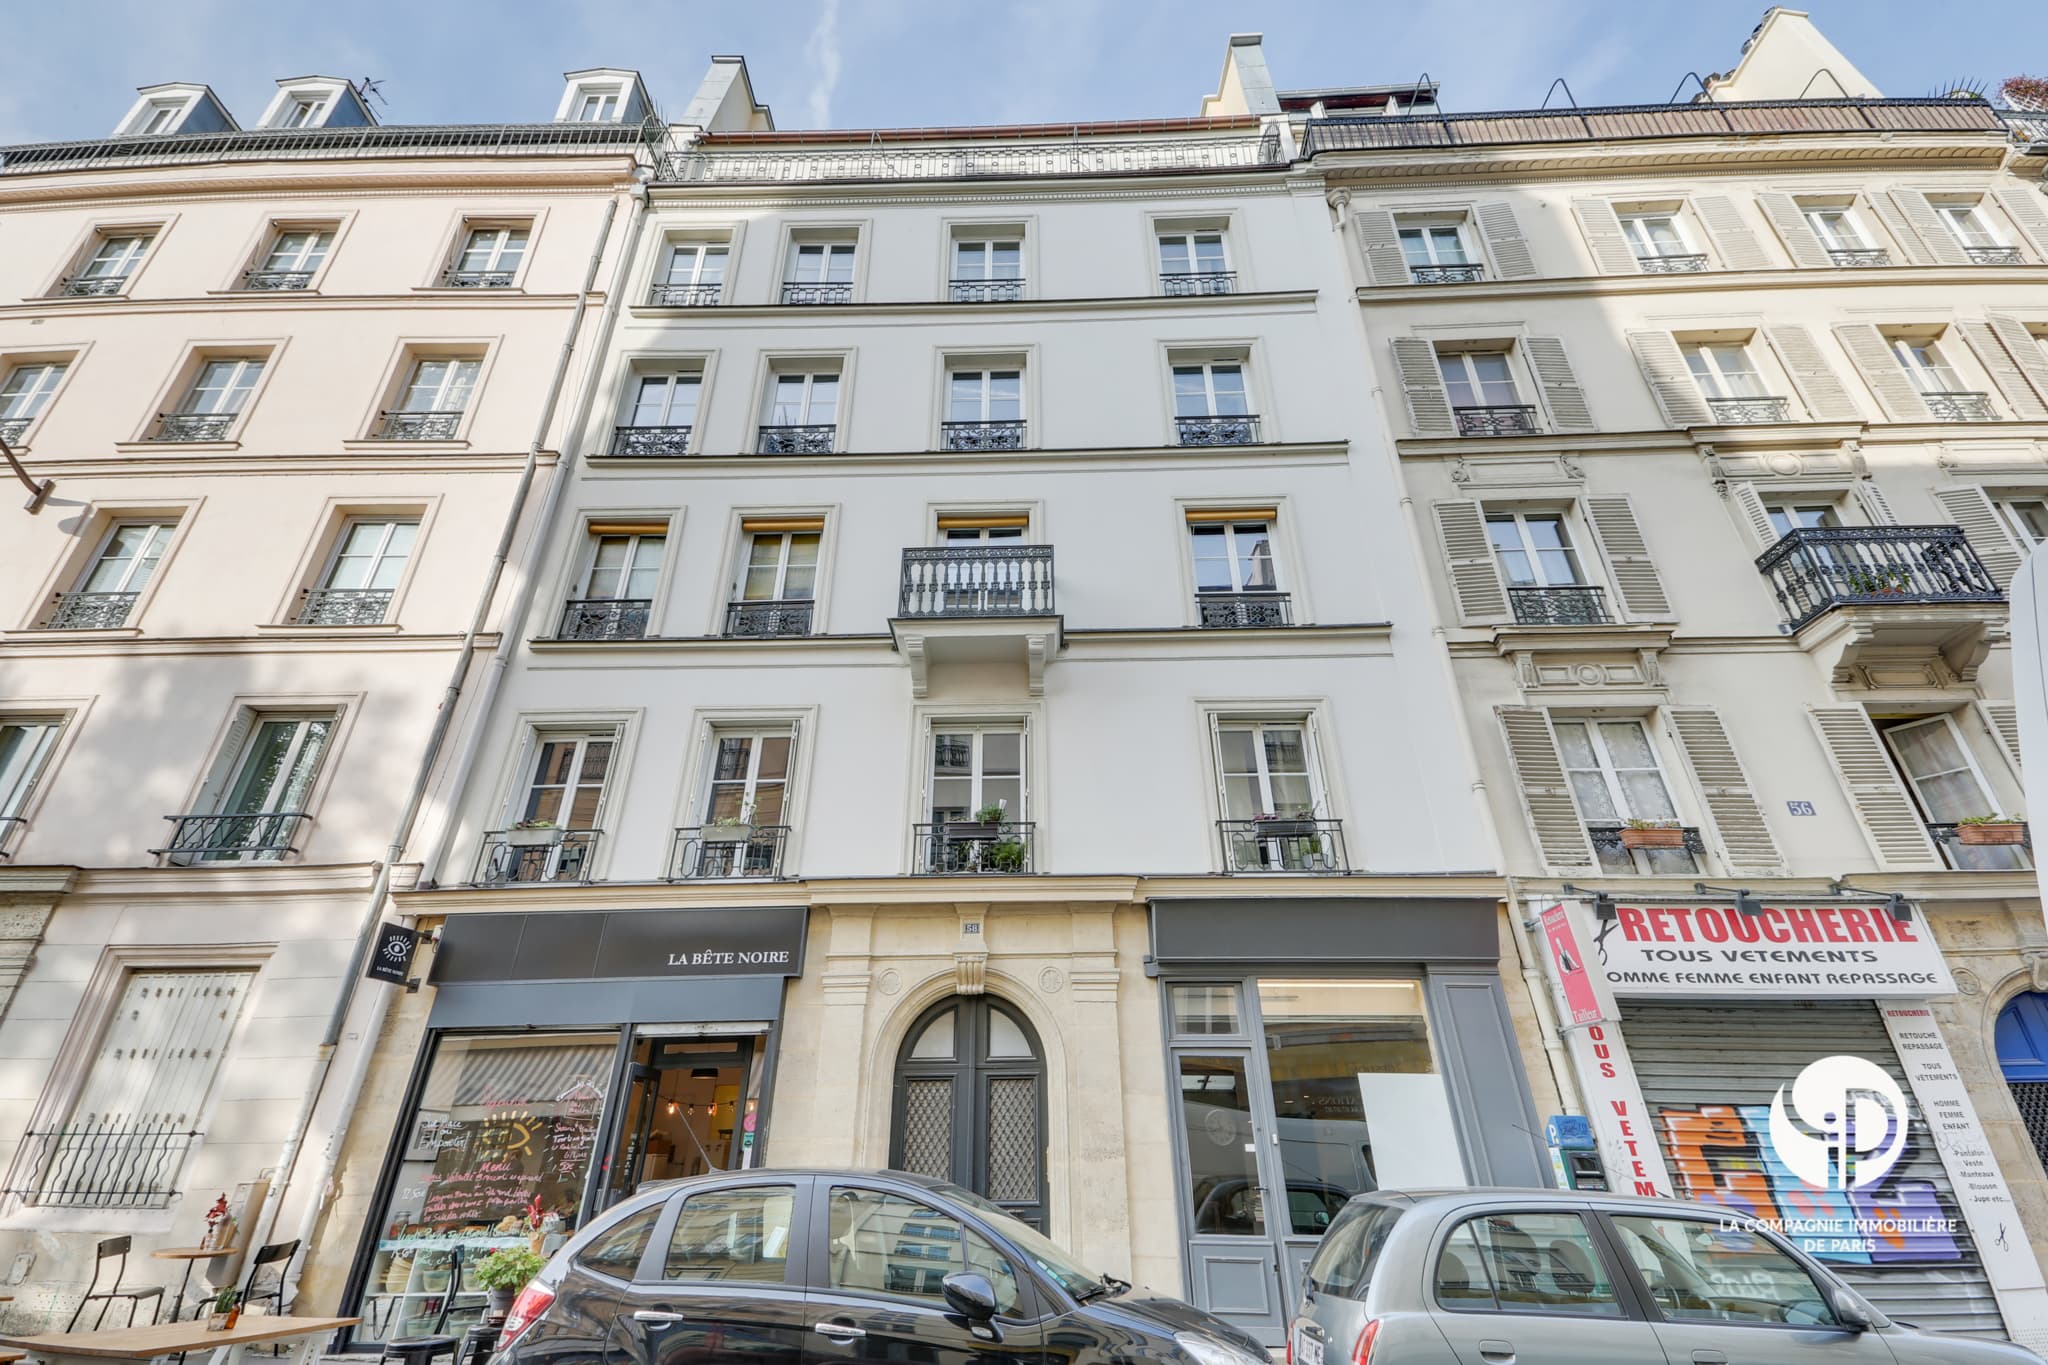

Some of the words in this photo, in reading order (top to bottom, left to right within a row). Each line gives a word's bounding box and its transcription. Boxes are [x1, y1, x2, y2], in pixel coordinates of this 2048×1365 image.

[1788, 801, 1813, 816] 56
[1615, 907, 1919, 944] RETOUCHERIE
[667, 952, 688, 966] LA
[691, 948, 735, 965] BÊTE
[737, 950, 790, 964] NOIRE
[1640, 949, 1713, 962] TOUS
[1720, 949, 1878, 963] VETEMENTS
[1606, 971, 1671, 984] OMME
[1675, 972, 1744, 984] FEMME
[1748, 972, 1821, 985] ENFANT
[1826, 972, 1939, 985] REPASSAGE
[1887, 1009, 1931, 1018] RETOUCHERIE
[1899, 1032, 1937, 1040] RETOUCHE
[1933, 1099, 1961, 1107] HOMME
[1588, 1024, 1617, 1079] OUS
[1610, 1100, 1657, 1198] VETEM
[1938, 1111, 1965, 1119] FEMME
[1942, 1122, 1971, 1130] ENFANT
[1548, 1124, 1558, 1145] P
